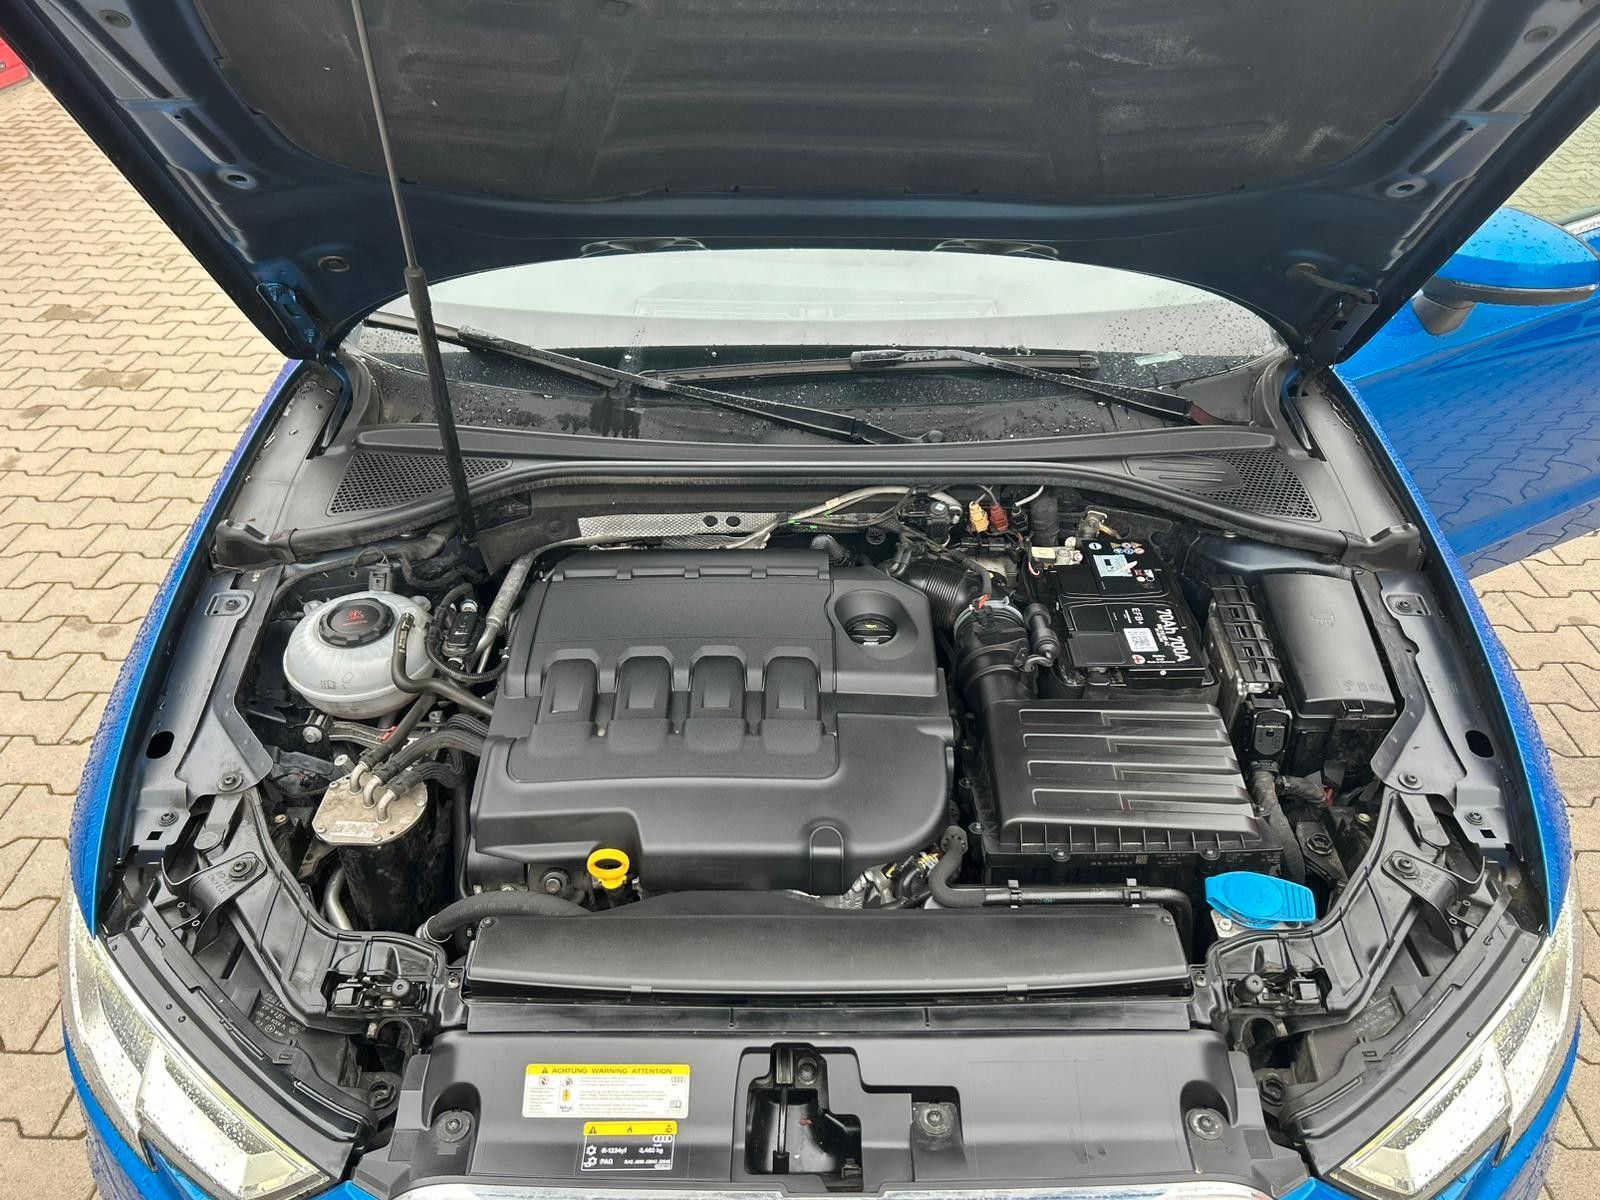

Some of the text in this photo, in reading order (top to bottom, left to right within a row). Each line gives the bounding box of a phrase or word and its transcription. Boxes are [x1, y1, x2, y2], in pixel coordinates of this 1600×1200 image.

[1131, 607, 1144, 624] EFB+
[1156, 608, 1179, 634] 70Ah
[1167, 635, 1191, 662] 700A
